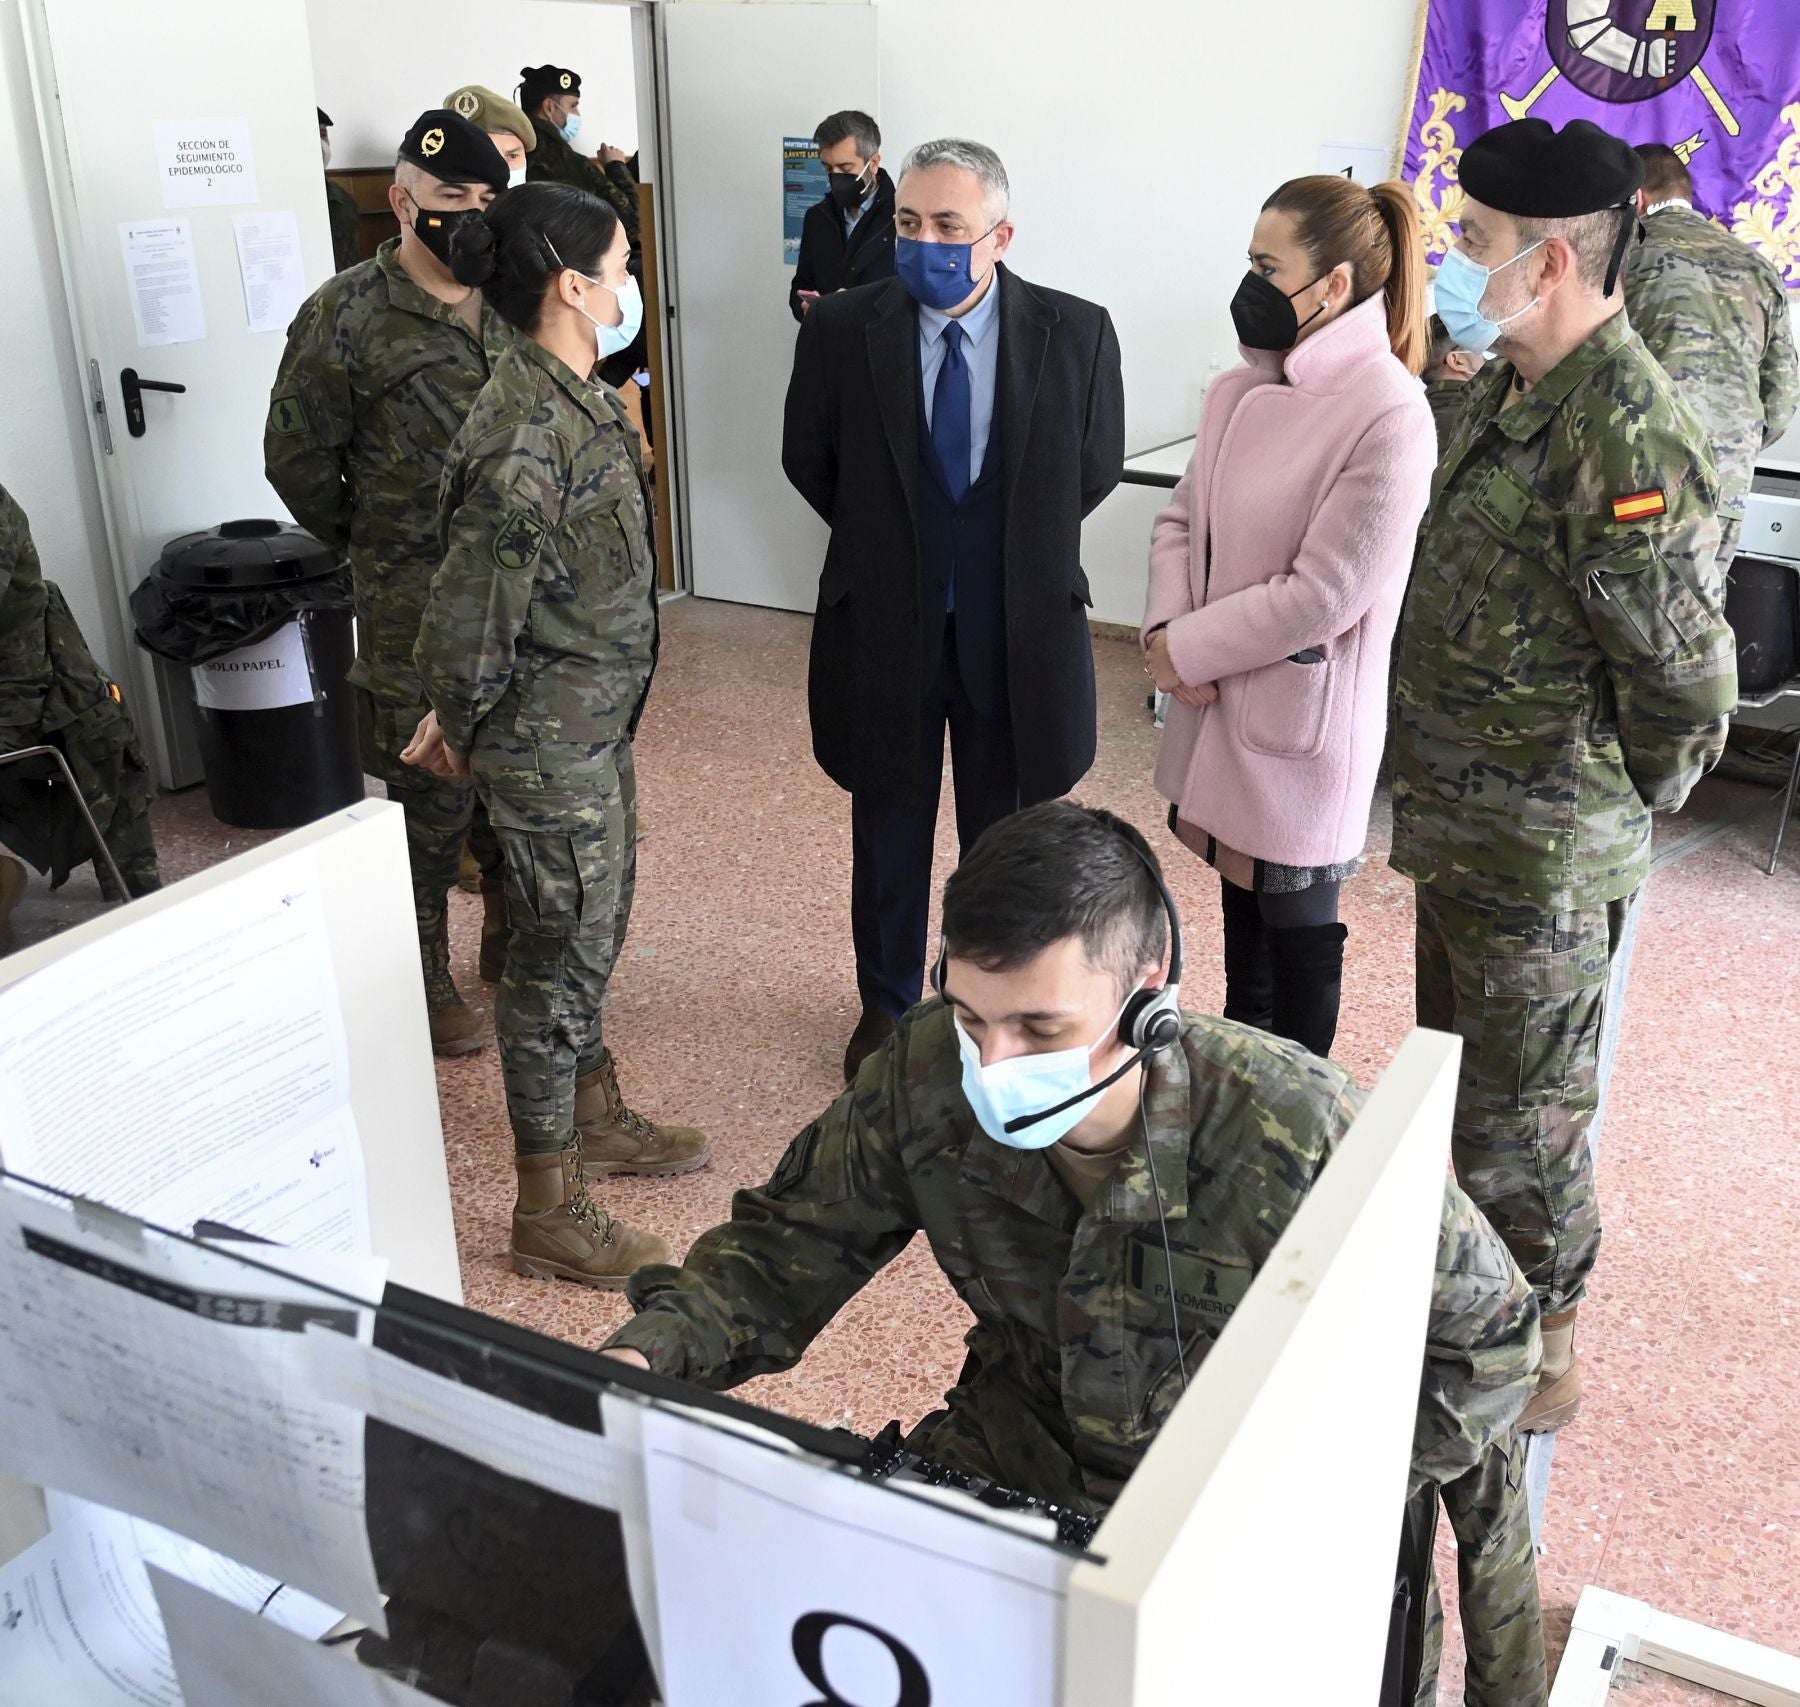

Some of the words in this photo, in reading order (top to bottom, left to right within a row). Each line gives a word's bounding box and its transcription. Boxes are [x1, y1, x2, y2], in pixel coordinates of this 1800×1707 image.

[177, 139, 216, 151] SECCIÓN
[218, 139, 230, 149] DE
[175, 152, 235, 163] SEGUIMIENTO
[168, 163, 243, 176] EPIDEMIOLÓGICO
[206, 178, 213, 187] 2
[206, 661, 240, 673] SOLO
[241, 658, 286, 672] PAPEL
[1154, 1283, 1237, 1316] PALOMERO
